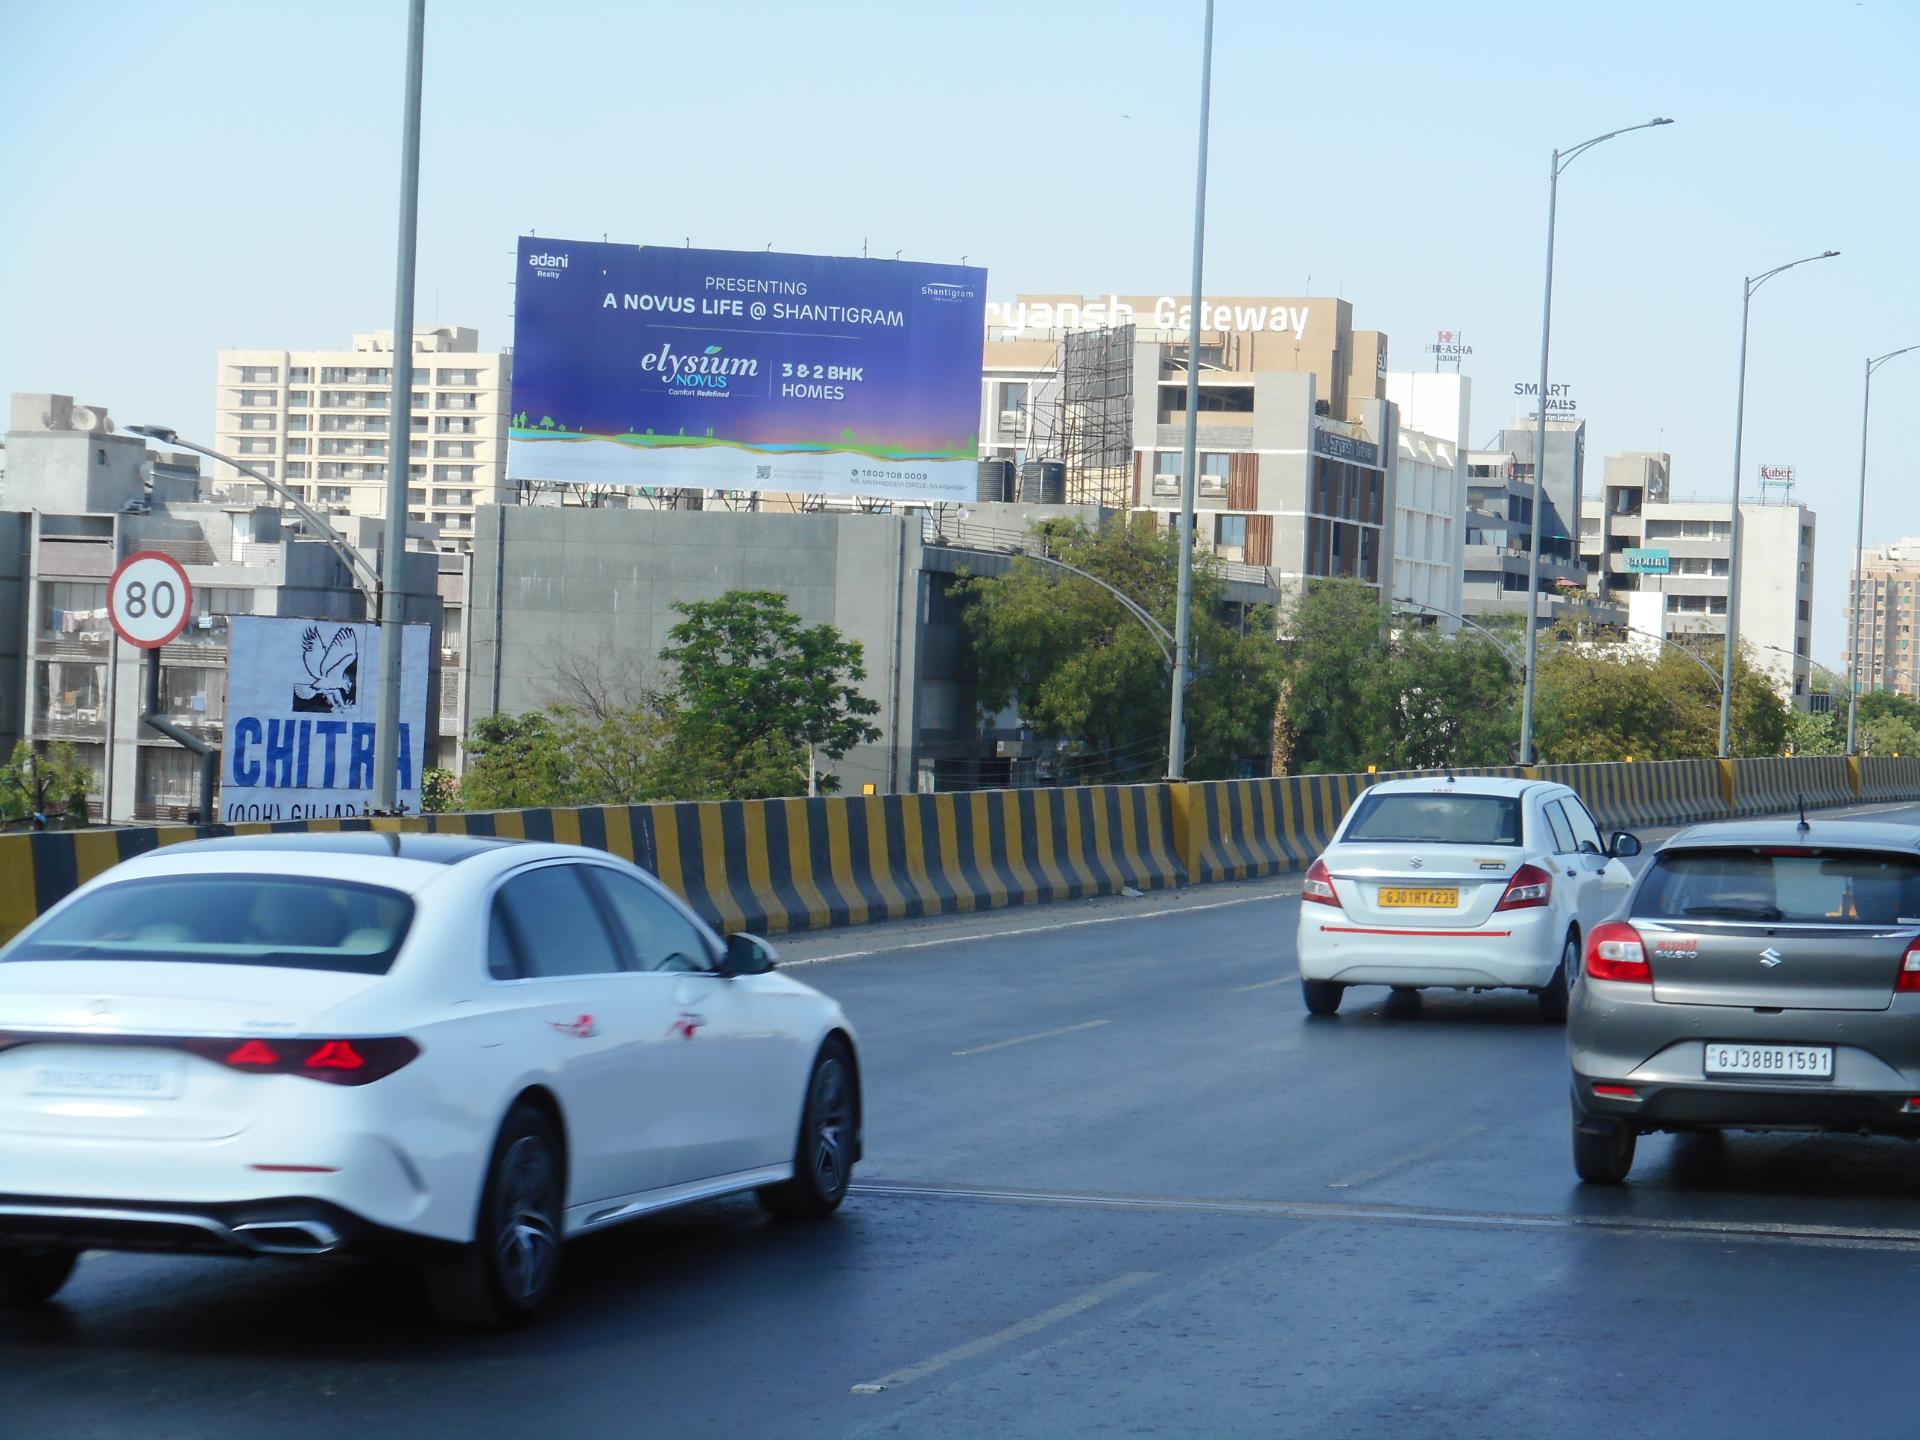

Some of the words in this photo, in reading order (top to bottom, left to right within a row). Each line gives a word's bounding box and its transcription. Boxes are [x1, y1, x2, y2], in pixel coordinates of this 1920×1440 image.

[529, 253, 568, 268] adani
[537, 270, 560, 279] Realty
[705, 277, 807, 296] PRESENTING
[921, 286, 974, 299] Shantigram
[603, 293, 618, 309] A
[624, 294, 696, 314] NOVUS
[702, 298, 744, 317] LIFE
[750, 301, 767, 320] @
[773, 303, 904, 328] SHANTIGRAM
[1155, 297, 1310, 341] Gateway
[641, 343, 759, 383] elysium
[782, 363, 794, 378] 3
[797, 364, 810, 378] &
[813, 365, 824, 380] 2
[828, 366, 864, 382] BHK
[676, 374, 728, 388] NOVUS
[668, 388, 696, 397] Comfort
[697, 389, 730, 399] Redefined
[782, 383, 845, 400] HOMES
[862, 469, 884, 478] 1800
[1761, 466, 1793, 480] Kuber
[1627, 557, 1666, 567] croma
[126, 581, 175, 619] 80
[1719, 1049, 1828, 1071] GJ38BB1591
